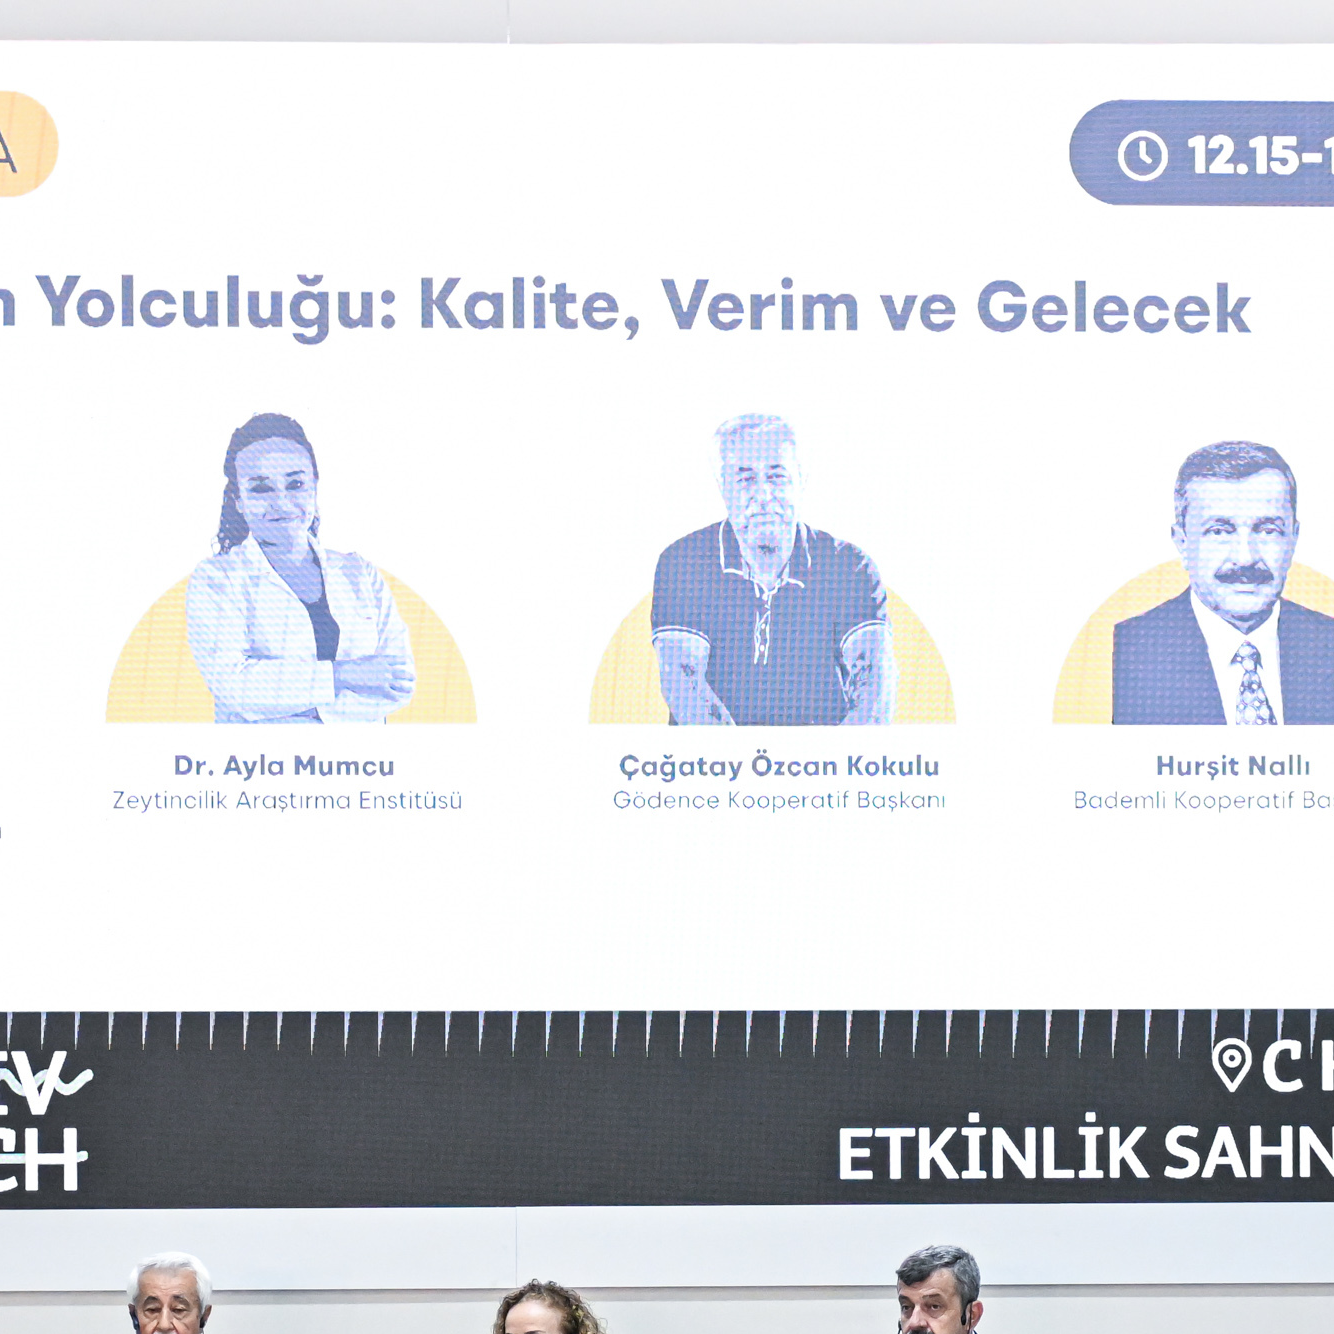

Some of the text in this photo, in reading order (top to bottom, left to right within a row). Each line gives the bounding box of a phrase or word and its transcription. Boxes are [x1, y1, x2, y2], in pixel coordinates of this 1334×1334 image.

[35, 274, 398, 346] Yolculuğu:
[419, 278, 641, 341] Kalite,
[661, 279, 858, 333] Verim
[880, 291, 956, 333] ve
[977, 279, 1251, 334] Gelecek
[175, 755, 394, 782] Dr. Ayla Mumcu
[619, 749, 939, 782] Çağatay Özcan Kokulu
[1157, 754, 1310, 780] Hurşit Nallı
[112, 790, 462, 814] Zeytincilik Araştırma Enstitüsü
[613, 790, 945, 813] Gödence Kooperatif Başkanı
[1074, 790, 1165, 809] Bademli
[1174, 790, 1294, 813] Kooperatif
[1262, 1039, 1303, 1093] C
[839, 1112, 1150, 1180] ETKİNLİK
